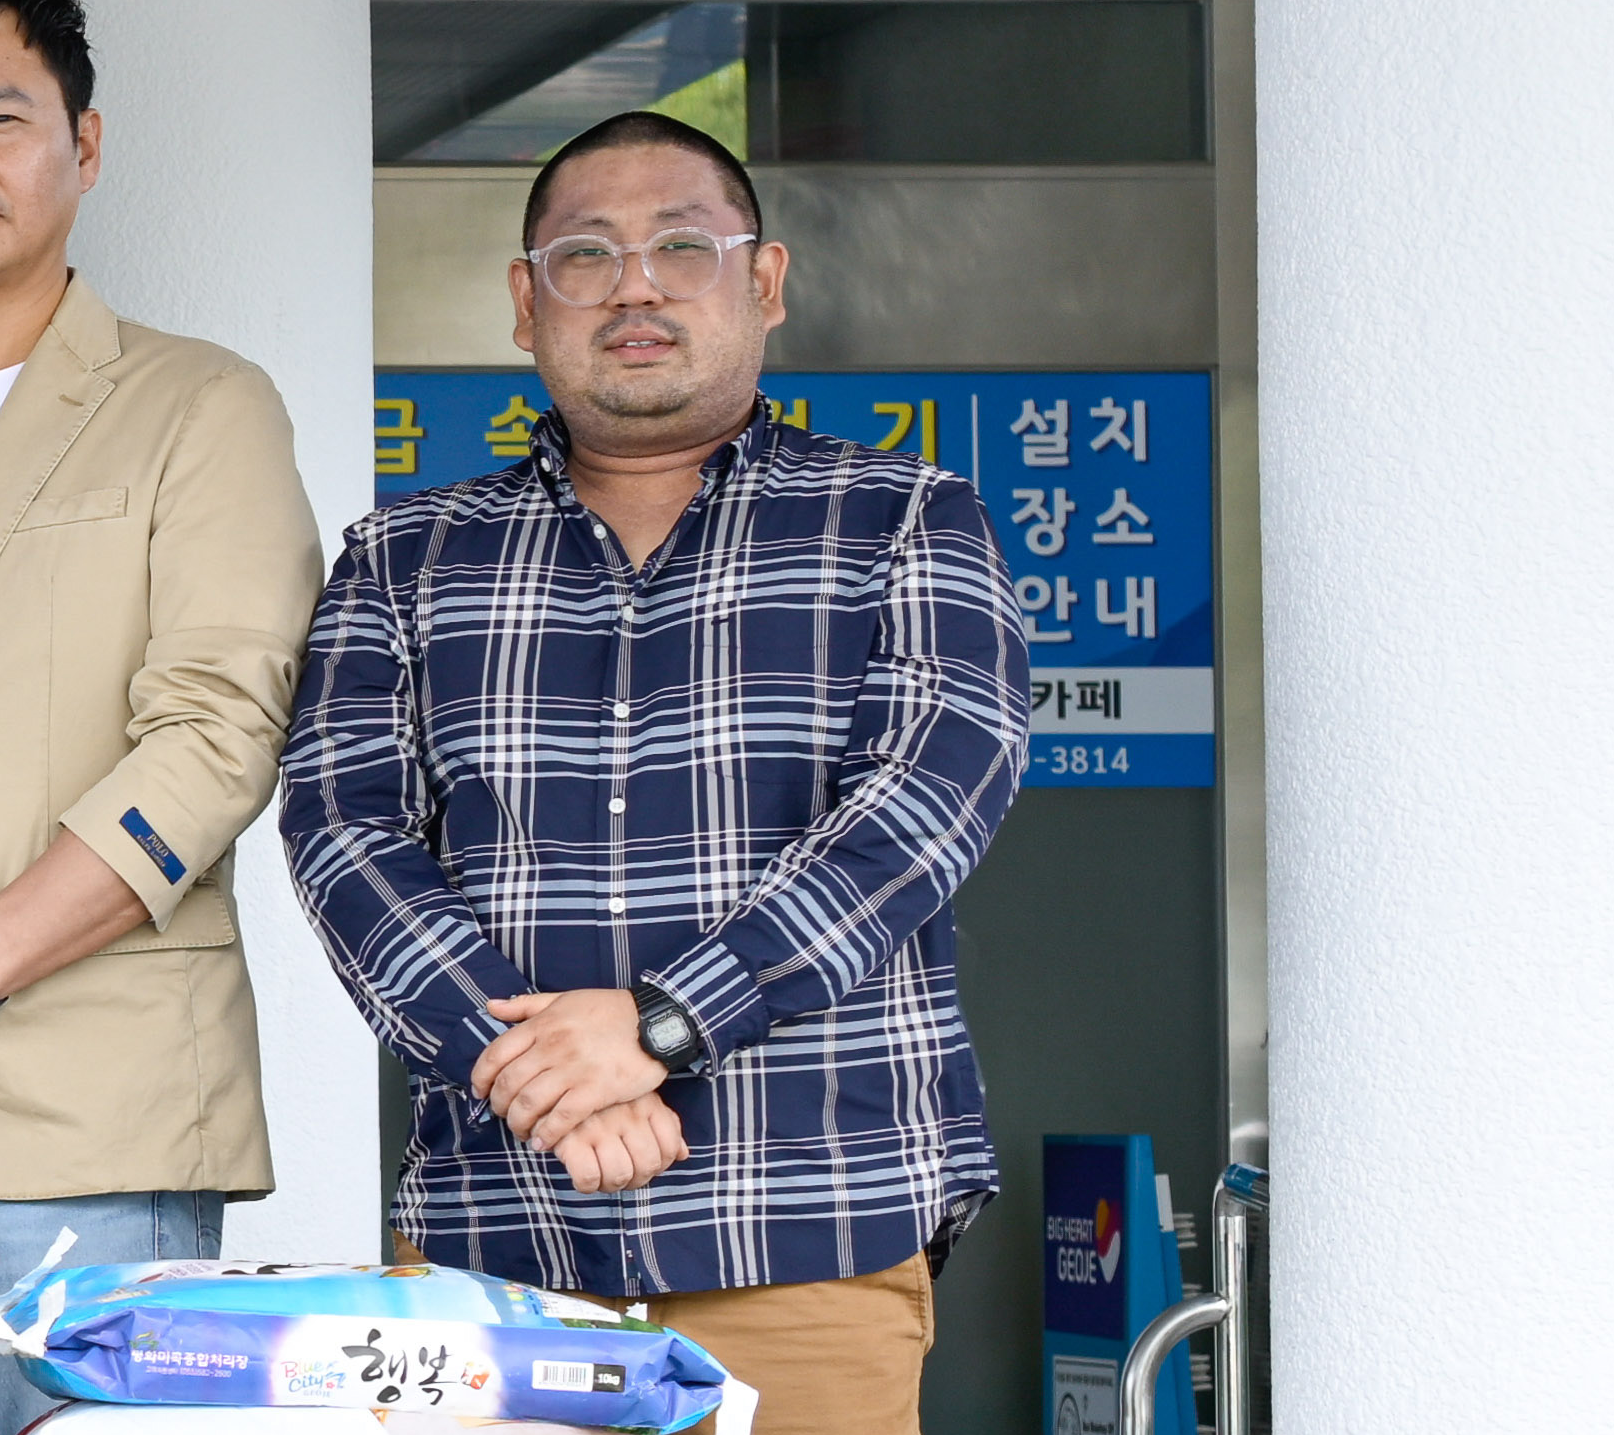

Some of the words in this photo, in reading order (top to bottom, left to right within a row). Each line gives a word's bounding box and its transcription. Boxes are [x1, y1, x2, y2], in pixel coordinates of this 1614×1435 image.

[1009, 397, 1147, 467] 설치
[1010, 486, 1155, 557] 장소
[1013, 574, 1157, 644] 안내
[1057, 1246, 1097, 1285] GEOJE
[342, 1327, 453, 1407] 행복
